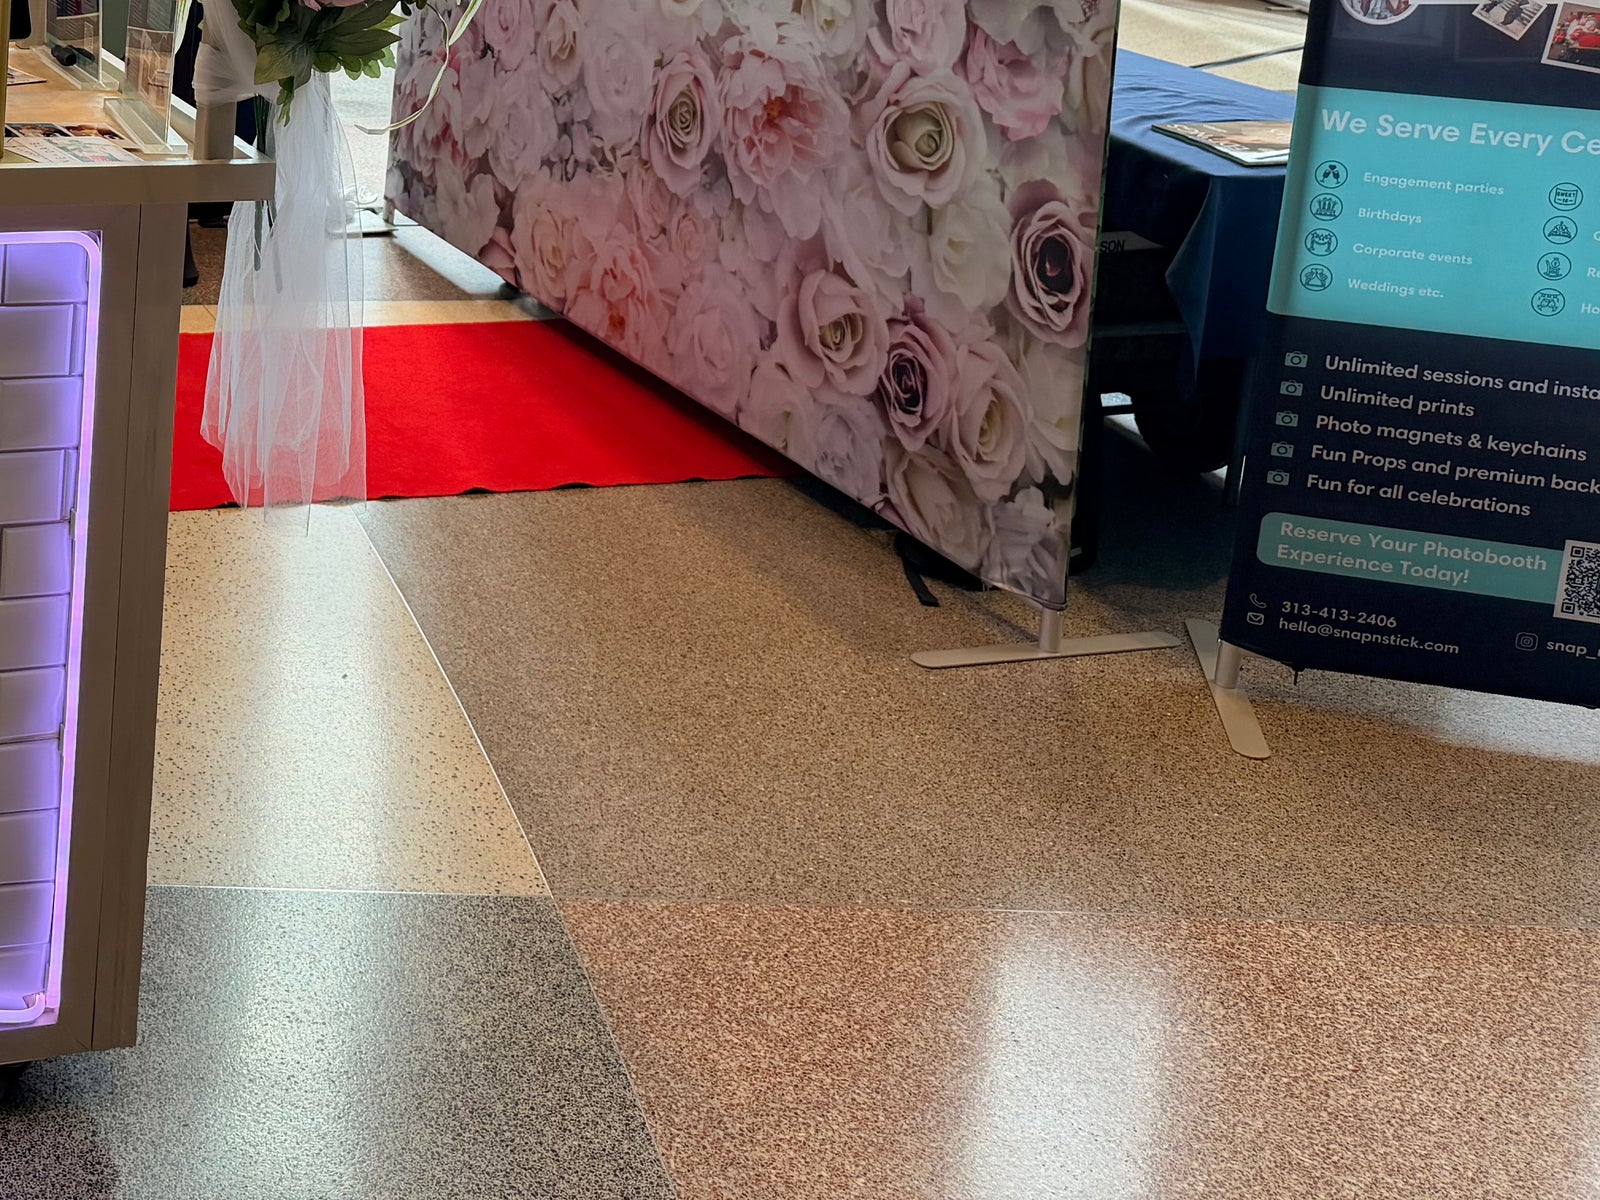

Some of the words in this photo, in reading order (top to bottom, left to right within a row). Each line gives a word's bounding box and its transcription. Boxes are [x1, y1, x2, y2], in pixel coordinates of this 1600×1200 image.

[1321, 108, 1368, 134] We
[1376, 113, 1461, 143] Serve
[1469, 122, 1553, 157] Every
[1363, 171, 1452, 190] Engagement
[1454, 182, 1505, 196] parties
[1358, 207, 1423, 225] Birthdays
[1352, 243, 1425, 261] Corporate
[1428, 252, 1473, 265] events
[1347, 278, 1415, 298] Weddings
[1418, 286, 1444, 298] etc.
[1324, 354, 1418, 380] Unlimited
[1422, 368, 1504, 390] sessions
[1508, 377, 1549, 396] and
[1320, 384, 1414, 411] Unlimited
[1417, 396, 1476, 417] prints
[1315, 414, 1372, 436] Photo
[1376, 424, 1463, 450] magnets
[1467, 433, 1483, 450] &
[1486, 435, 1588, 462] keychains
[1311, 444, 1347, 464] Fun
[1352, 449, 1407, 471] Props
[1411, 455, 1451, 475] and
[1454, 463, 1545, 489] premium
[1550, 473, 1600, 495] back
[1306, 473, 1342, 493] Fun
[1347, 477, 1376, 497] for
[1379, 483, 1404, 501] all
[1407, 487, 1532, 517] celebrations
[1276, 544, 1394, 574] Experience
[1399, 560, 1471, 586] Today!
[1280, 521, 1362, 547] Reserve
[1368, 532, 1418, 555] Your
[1422, 540, 1548, 572] Photobooth
[1281, 600, 1398, 629] 313-413-2406
[1278, 616, 1461, 655] hello@snapnstick.com
[1545, 640, 1600, 660] snap_
